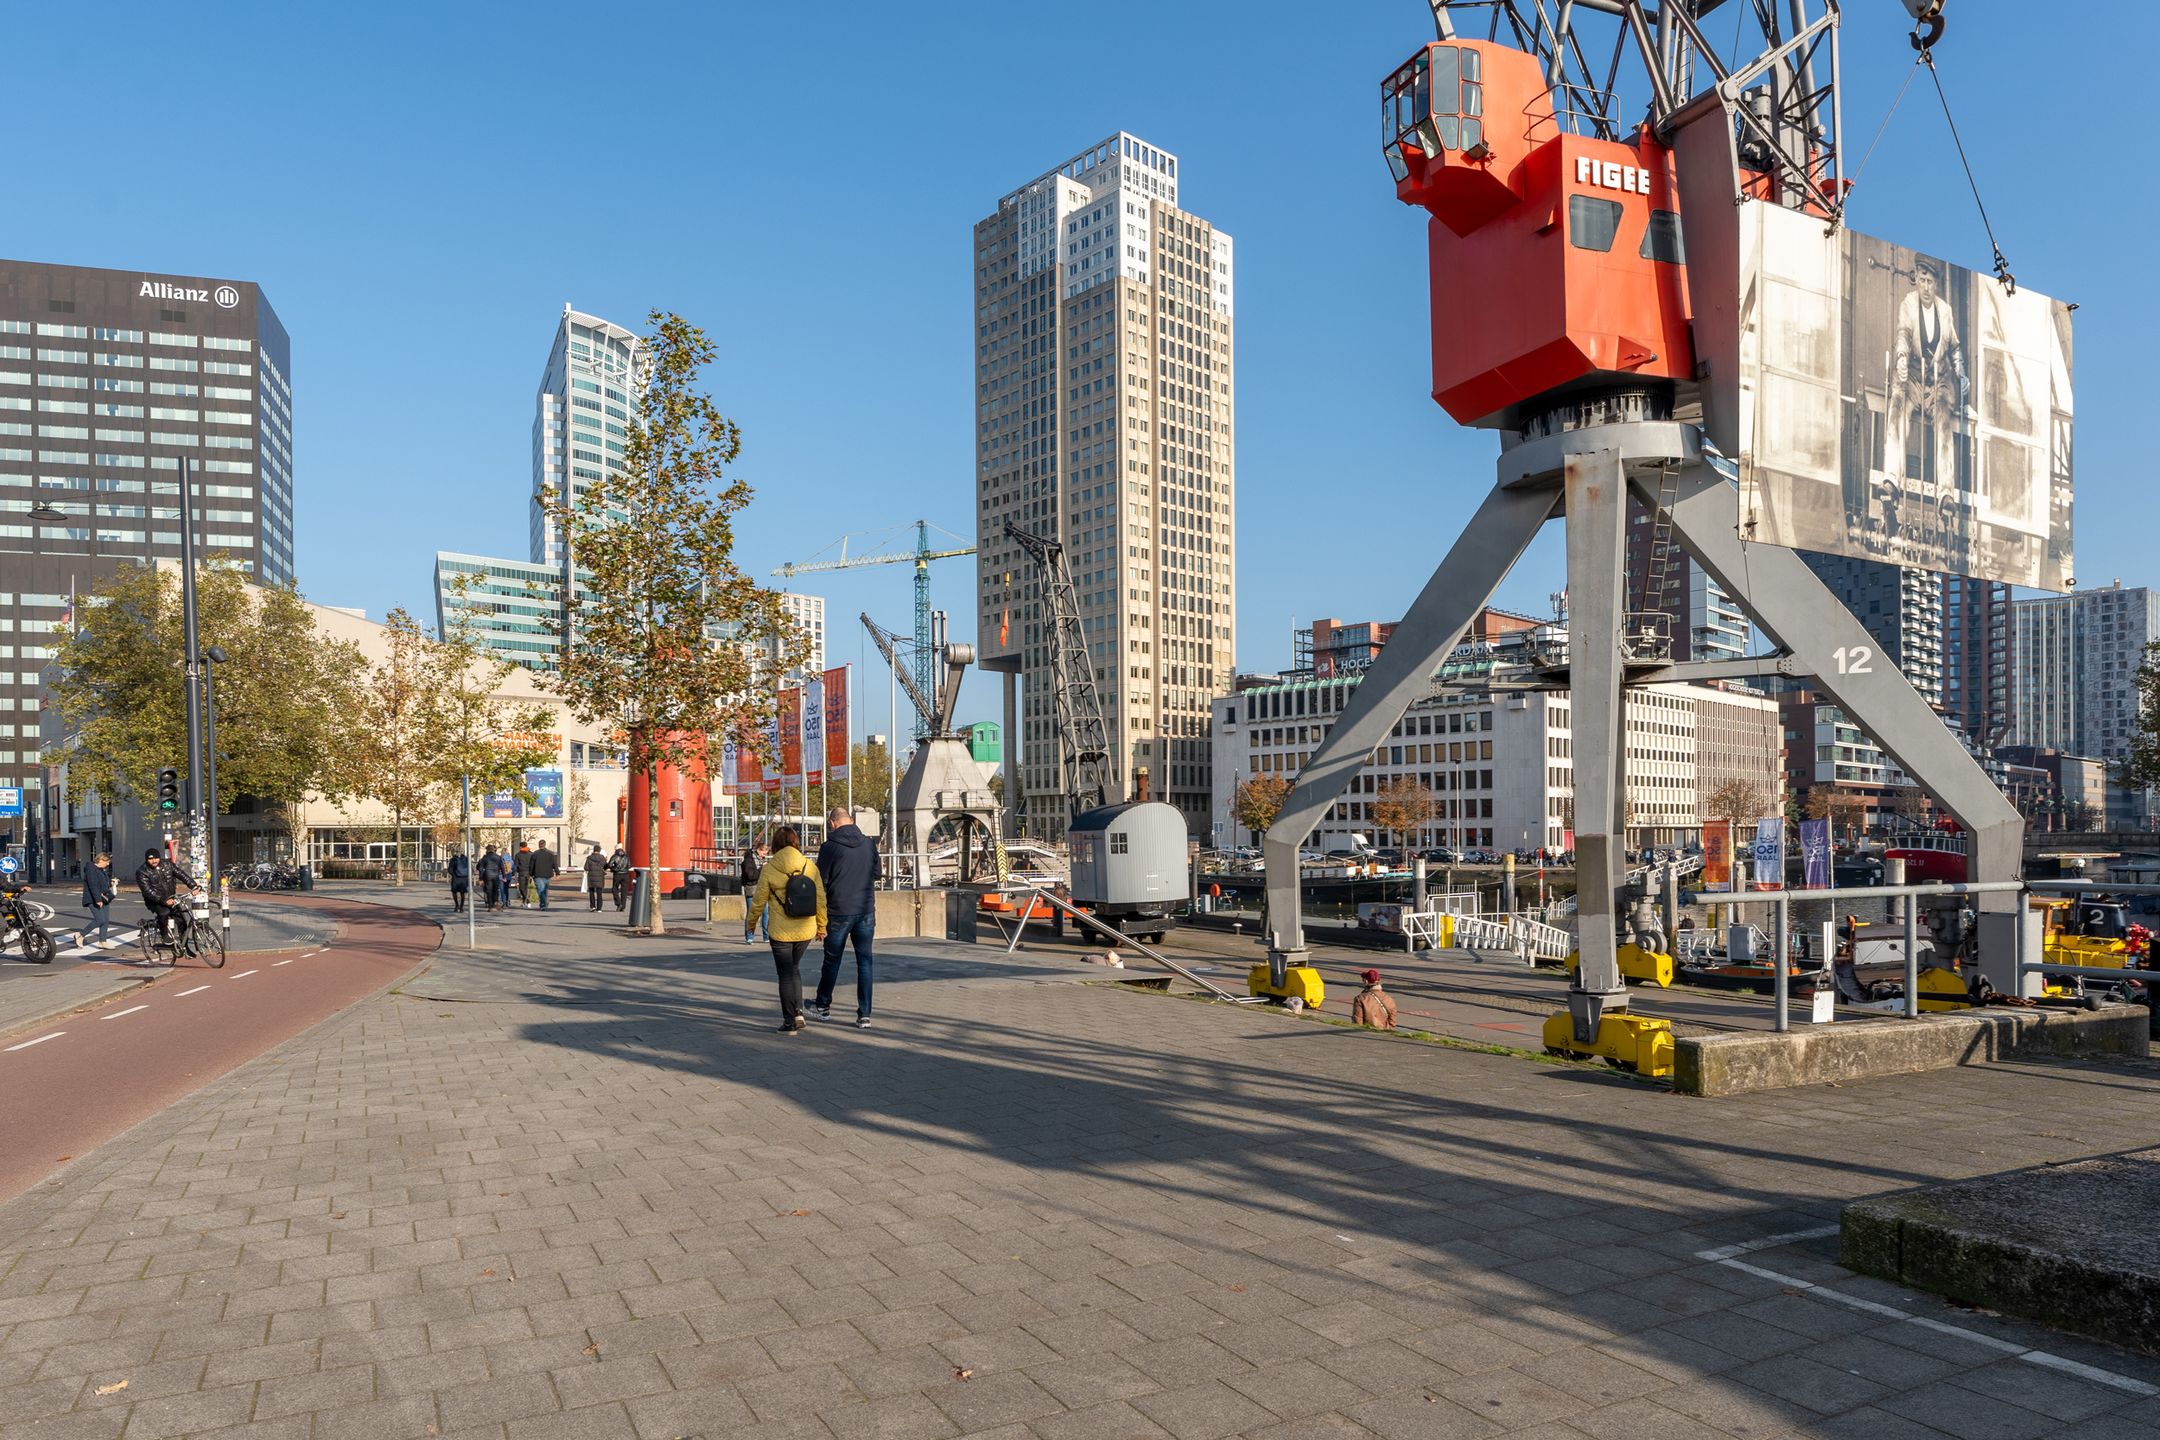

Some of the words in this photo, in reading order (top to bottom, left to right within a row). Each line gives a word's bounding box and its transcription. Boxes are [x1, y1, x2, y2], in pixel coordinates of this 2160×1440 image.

[1576, 156, 1650, 195] FIGEE
[140, 281, 208, 302] Allianz
[1832, 646, 1872, 674] 12
[2090, 909, 2104, 925] 2
